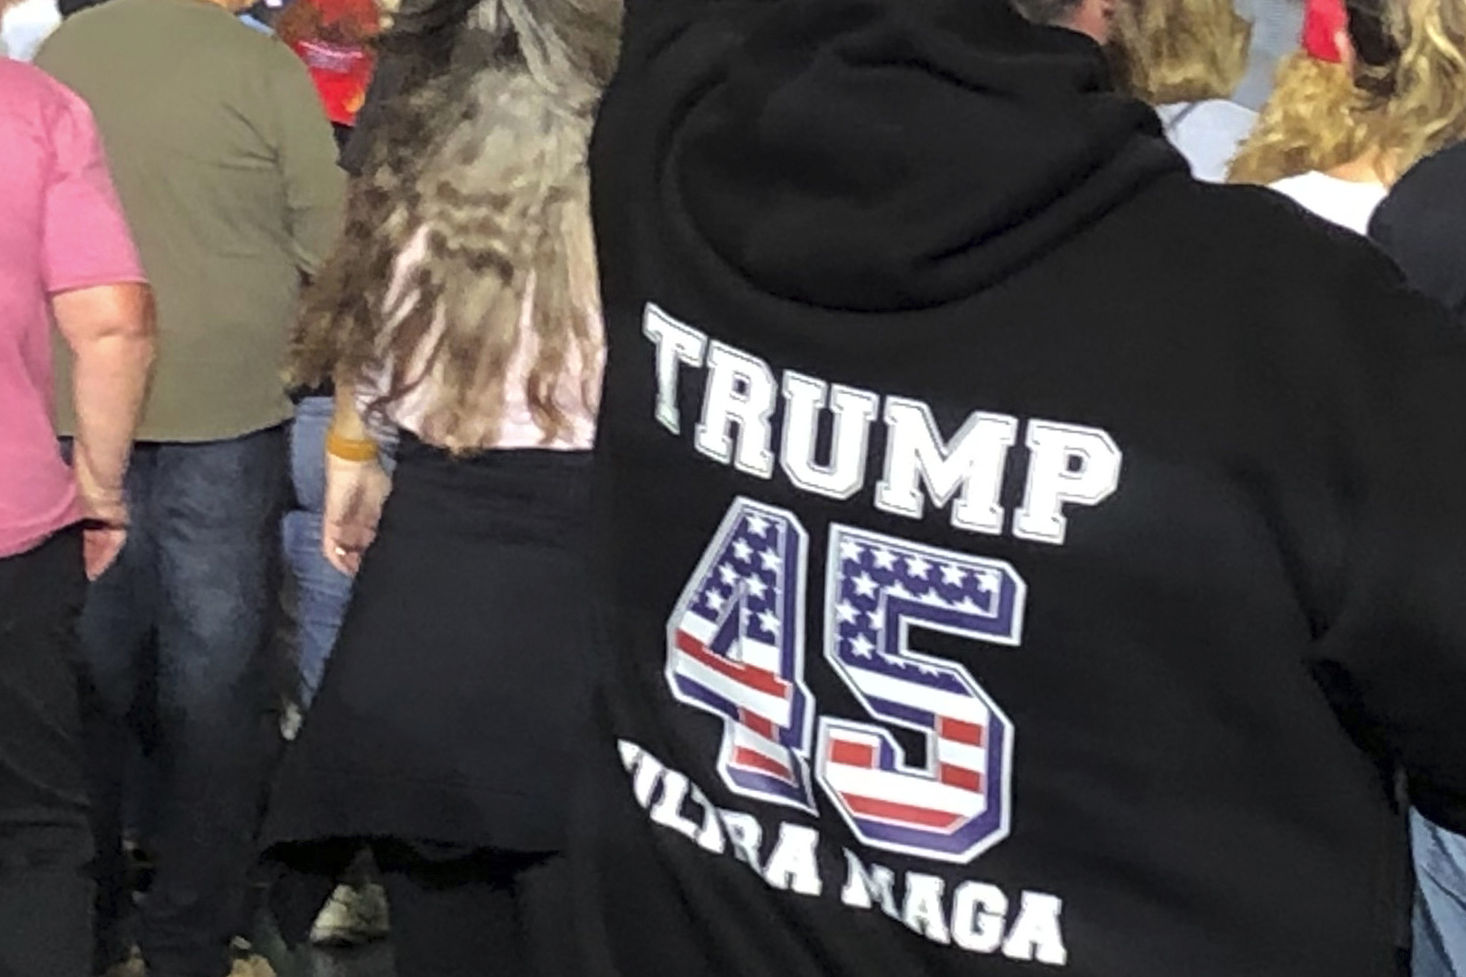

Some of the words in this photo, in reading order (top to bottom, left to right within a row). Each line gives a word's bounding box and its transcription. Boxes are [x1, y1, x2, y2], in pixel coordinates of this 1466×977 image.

[643, 302, 1124, 546] TRUMP
[665, 495, 1027, 865] 45
[840, 847, 1069, 967] MAGA
